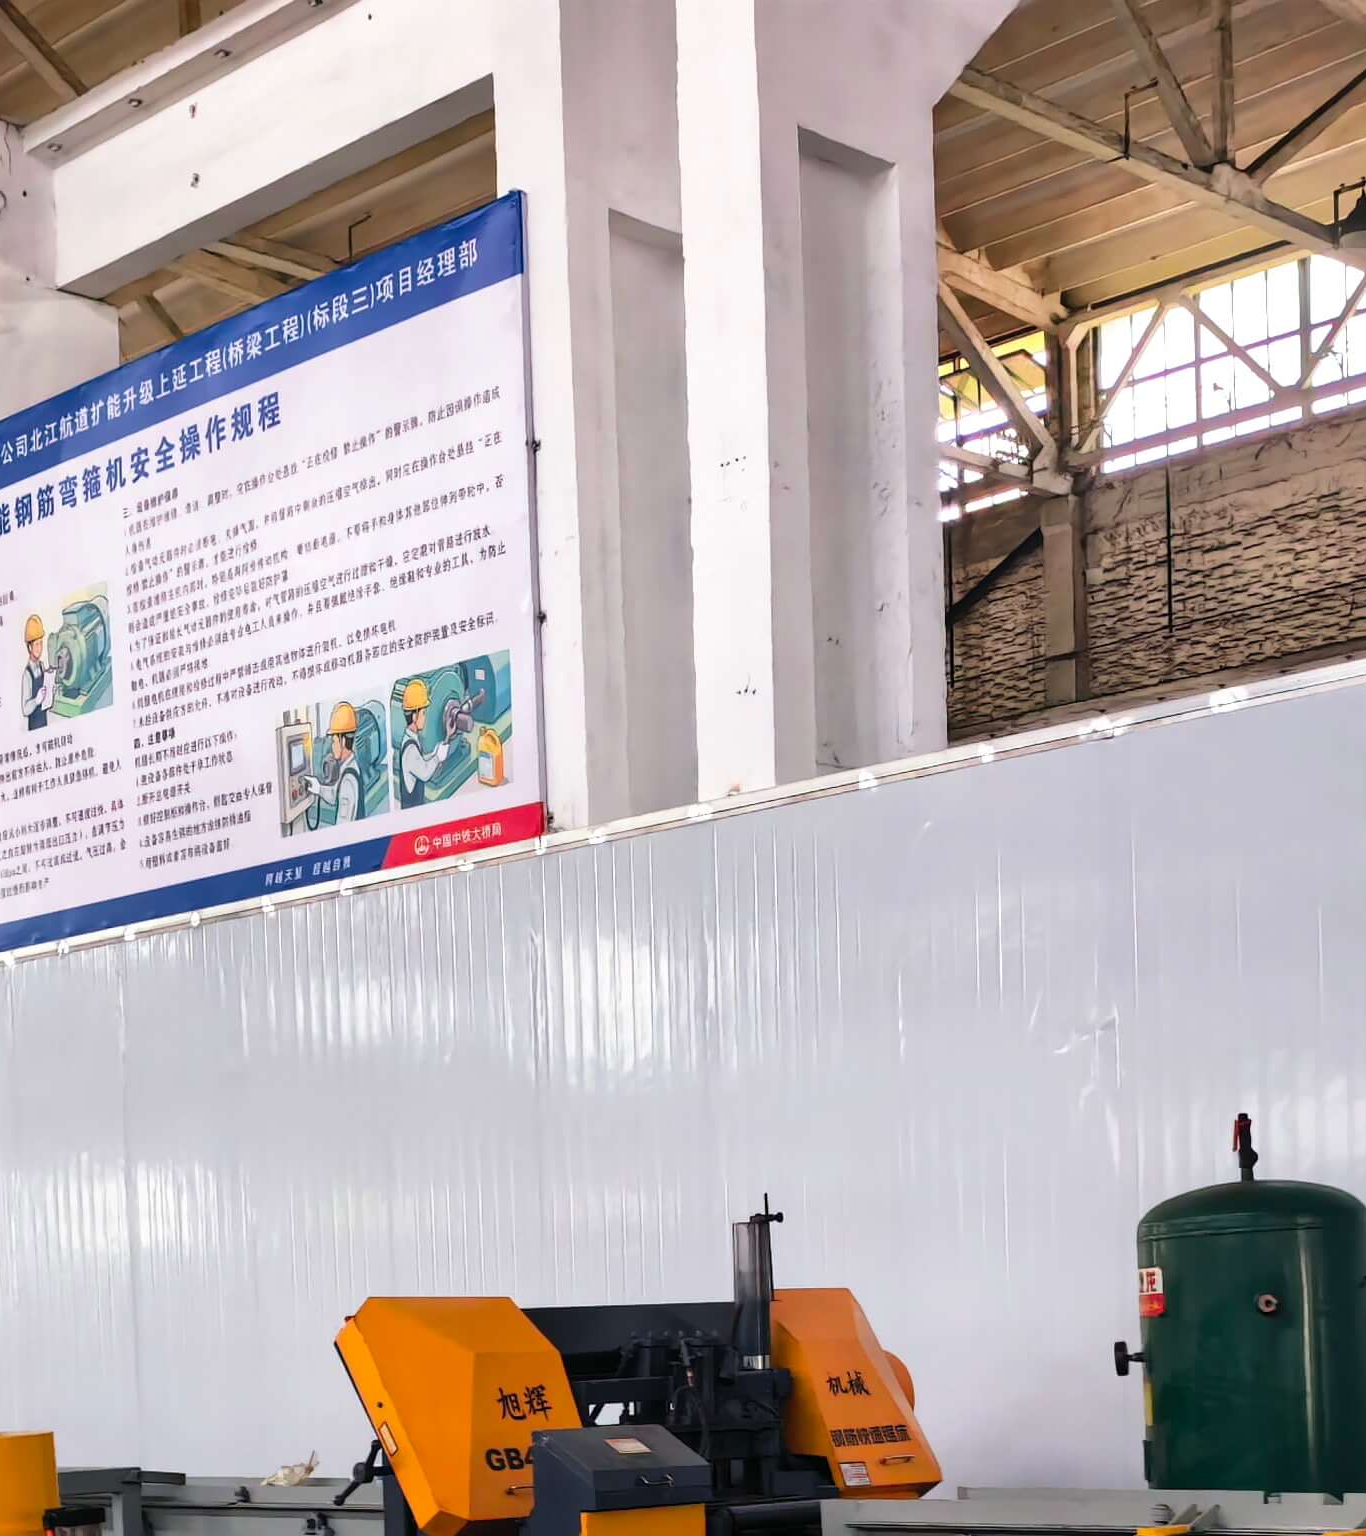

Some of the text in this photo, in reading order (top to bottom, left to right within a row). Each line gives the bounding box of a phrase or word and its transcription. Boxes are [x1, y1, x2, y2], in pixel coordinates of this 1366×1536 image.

[432, 820, 503, 850] 中国中铁大桥局
[826, 1369, 872, 1397] 机械
[497, 1383, 553, 1422] 旭辉
